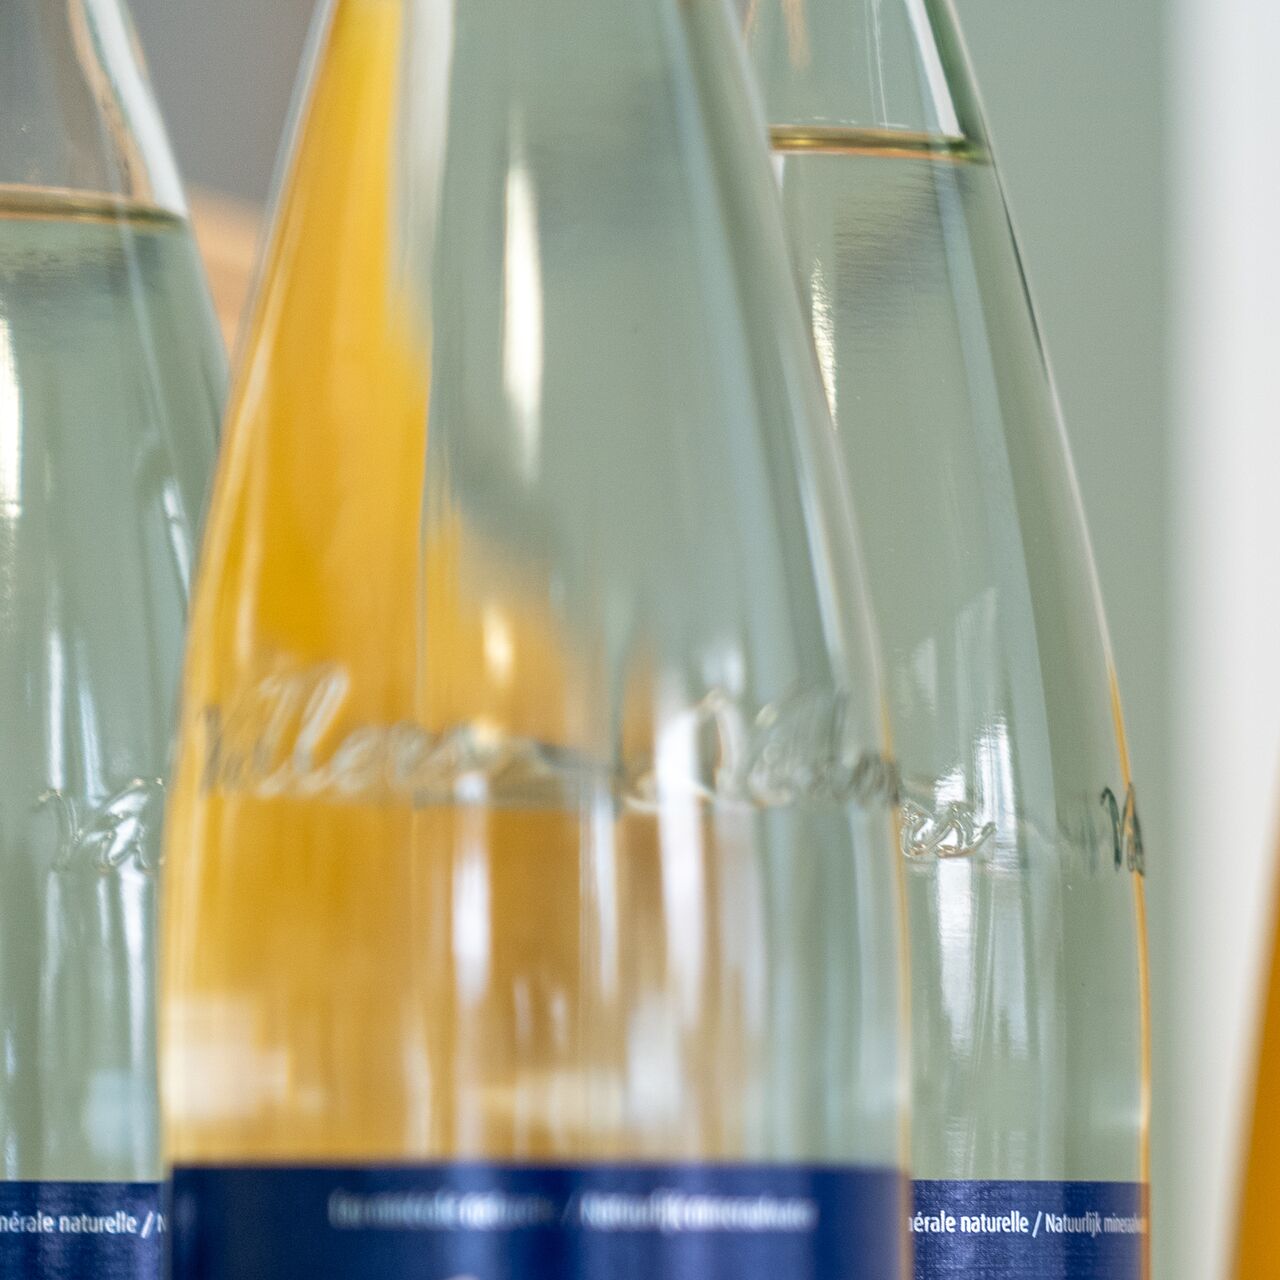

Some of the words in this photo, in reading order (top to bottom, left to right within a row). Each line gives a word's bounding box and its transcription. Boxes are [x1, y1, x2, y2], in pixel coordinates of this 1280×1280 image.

[59, 1210, 137, 1234] naturelle
[960, 1210, 1029, 1233] naturelle
[1045, 1211, 1102, 1238] Natuurlijk
